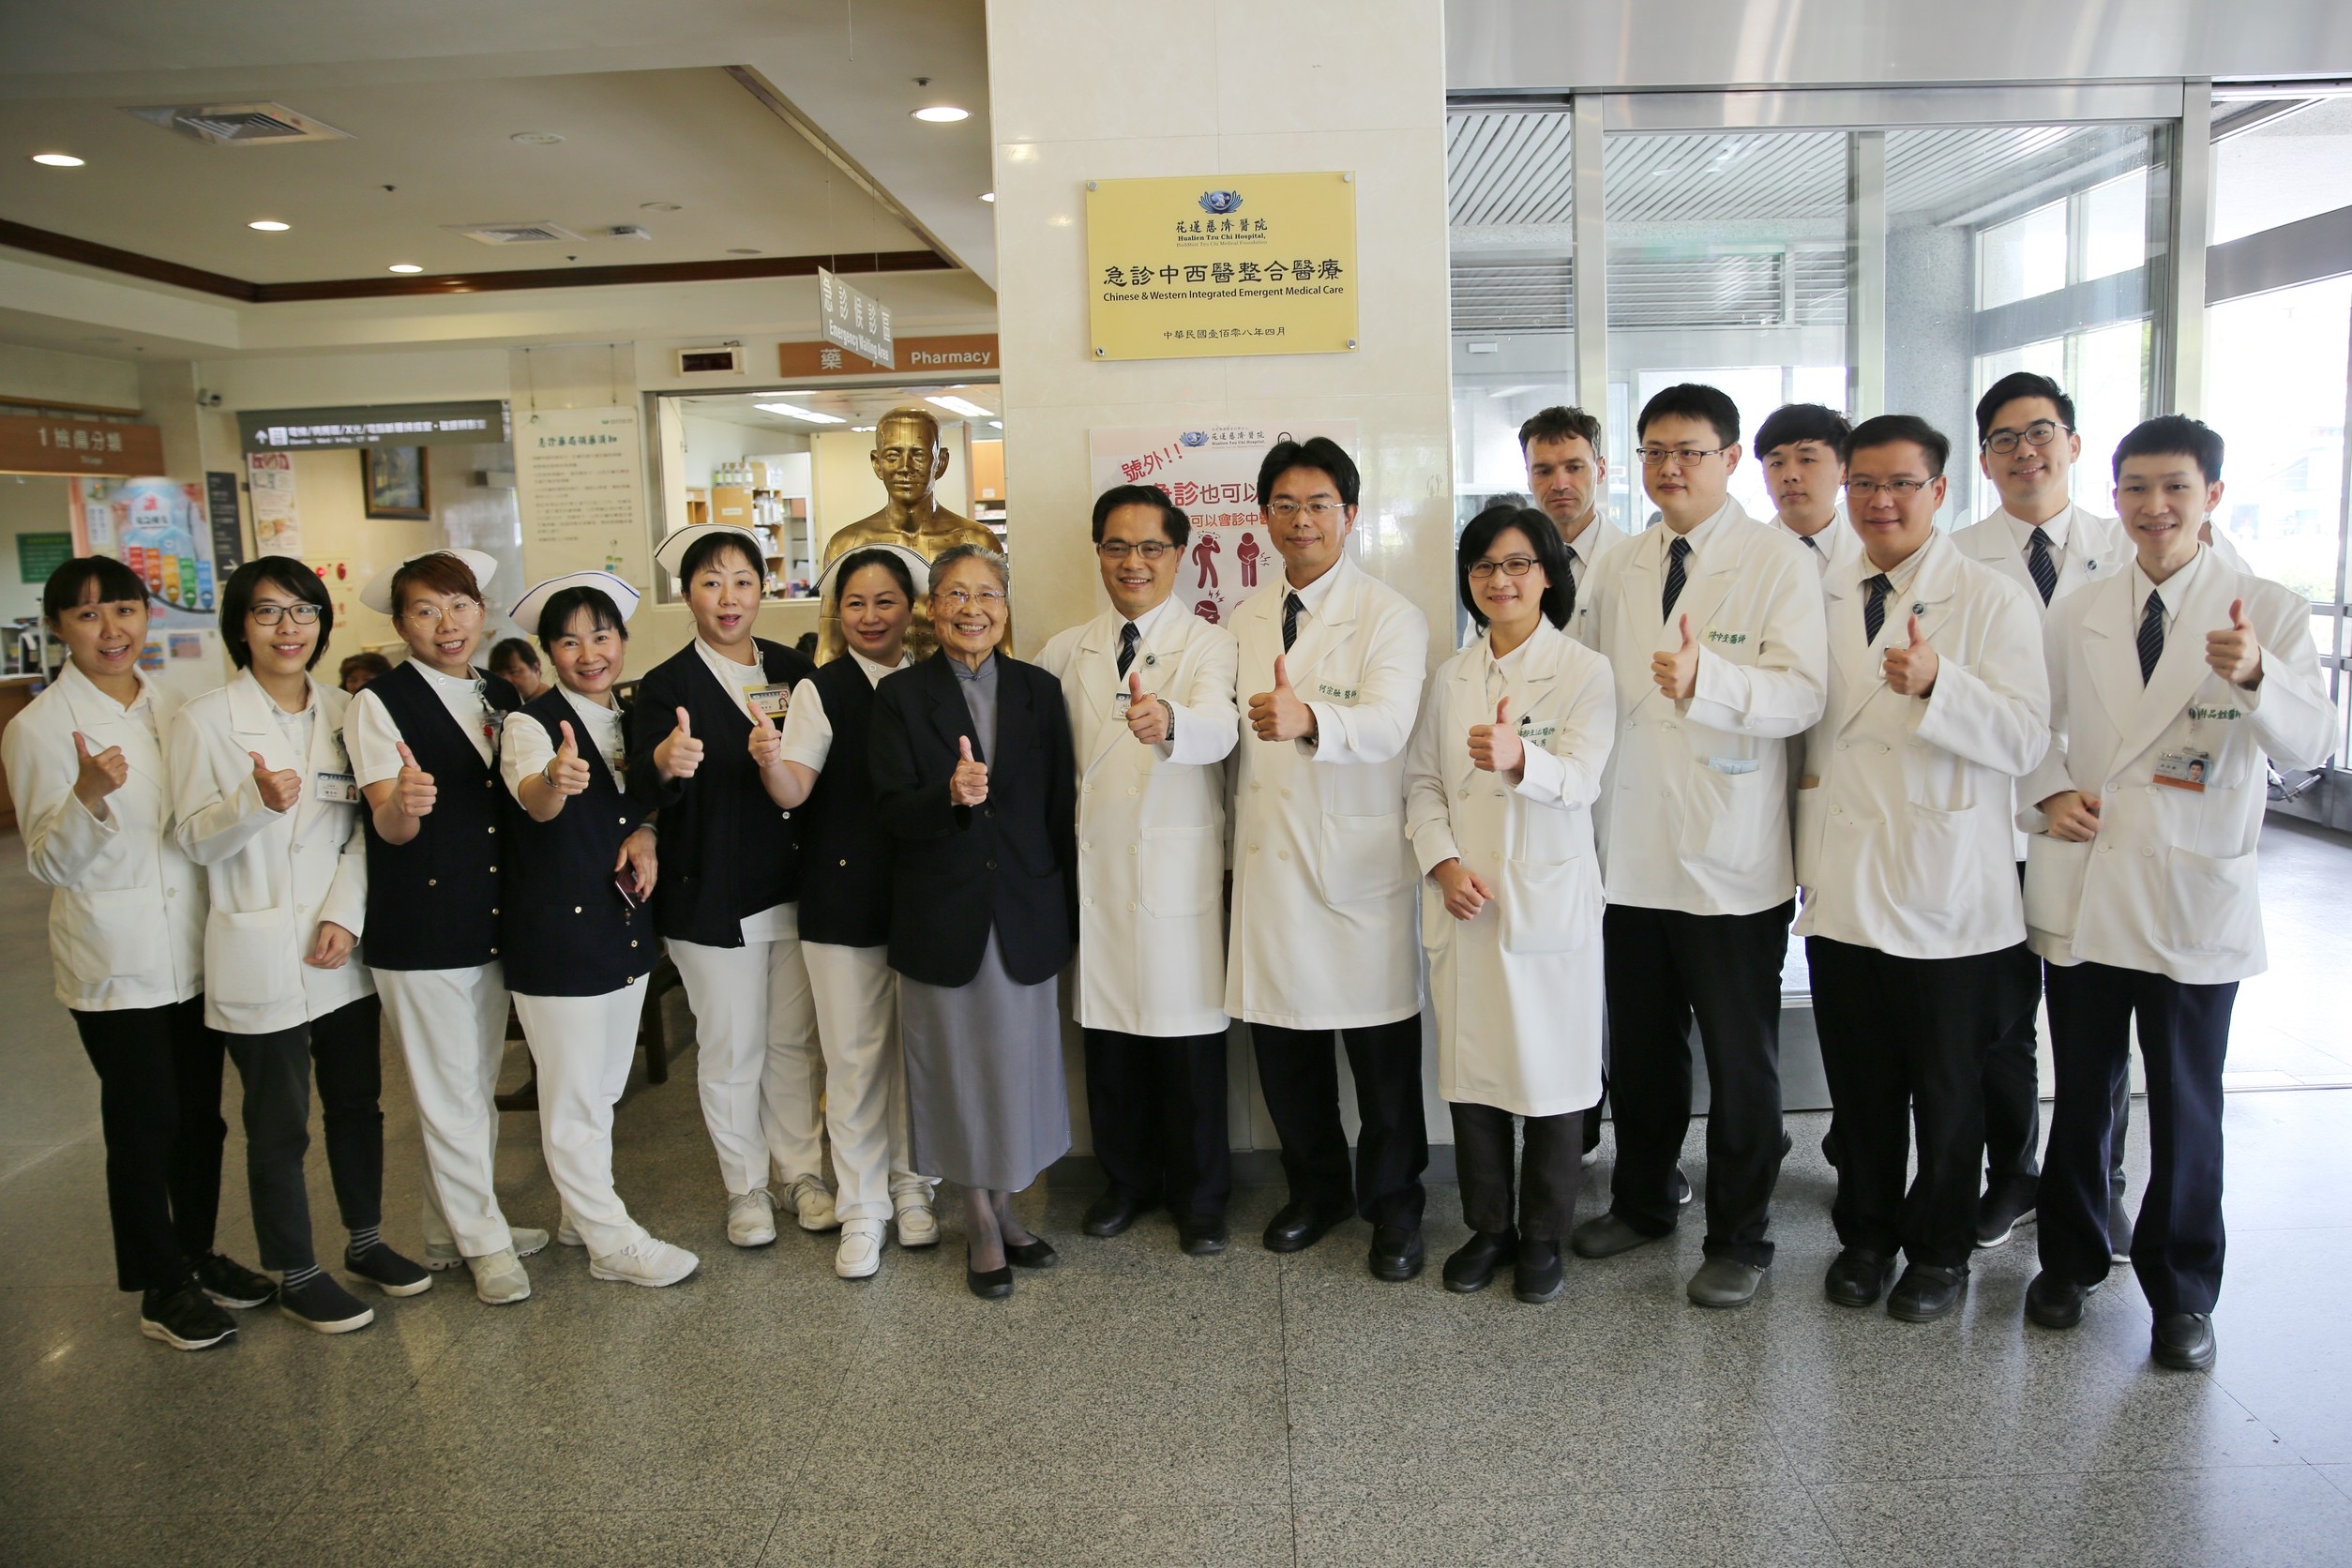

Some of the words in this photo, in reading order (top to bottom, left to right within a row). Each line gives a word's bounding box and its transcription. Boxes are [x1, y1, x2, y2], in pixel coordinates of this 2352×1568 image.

[1176, 219, 1268, 233] 花蓮慈濟醫院
[1104, 259, 1343, 287] 急診中西醫整合醫療
[1103, 293, 1139, 301] Chinese
[1141, 292, 1149, 300] &
[1150, 291, 1187, 299] Western
[1189, 288, 1237, 300] Integrated
[1239, 287, 1283, 298] Emergent
[1286, 286, 1321, 295] Medical
[1323, 285, 1344, 294] Care
[822, 276, 891, 342] 急診候診區
[829, 319, 858, 351] Emergency
[858, 334, 878, 359] Waiting
[878, 343, 889, 361] Area
[911, 351, 991, 365] Pharmacy
